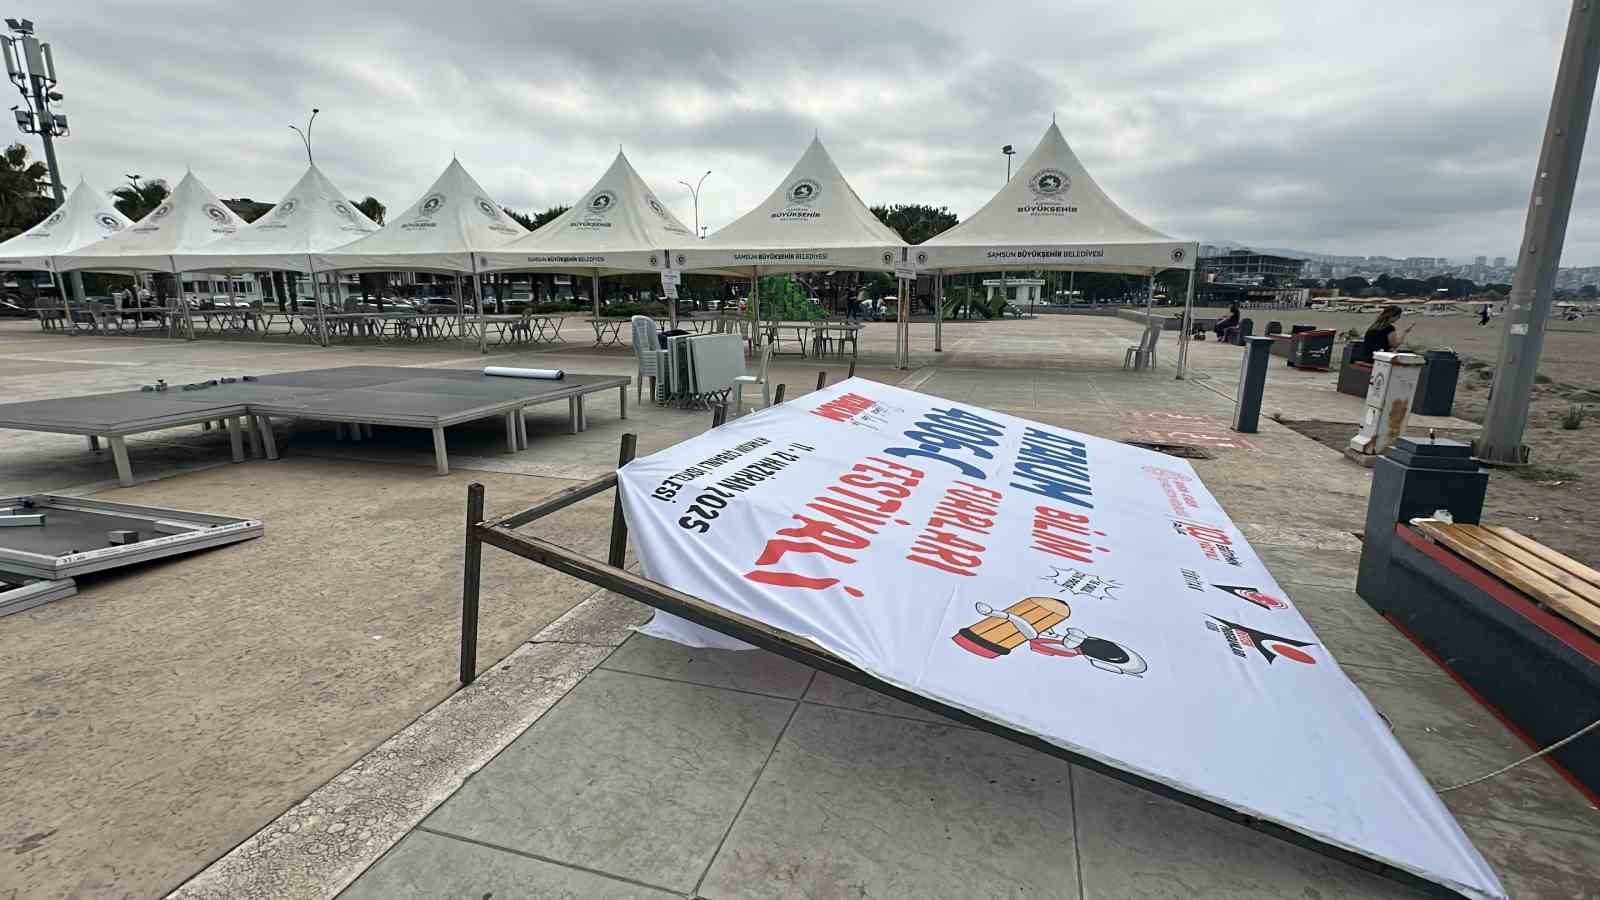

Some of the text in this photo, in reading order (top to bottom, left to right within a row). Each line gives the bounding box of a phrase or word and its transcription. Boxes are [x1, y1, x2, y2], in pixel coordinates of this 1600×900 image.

[987, 249, 1016, 257] SAMSUN
[771, 451, 800, 462] 12
[884, 408, 1006, 480] 4006-C
[716, 457, 793, 493] HAZİRAN
[1009, 426, 1111, 564] ATAKUM BİLİM
[678, 486, 735, 533] 2025
[744, 456, 925, 598] FESTİVALİ
[906, 480, 1003, 576] FUARLARI
